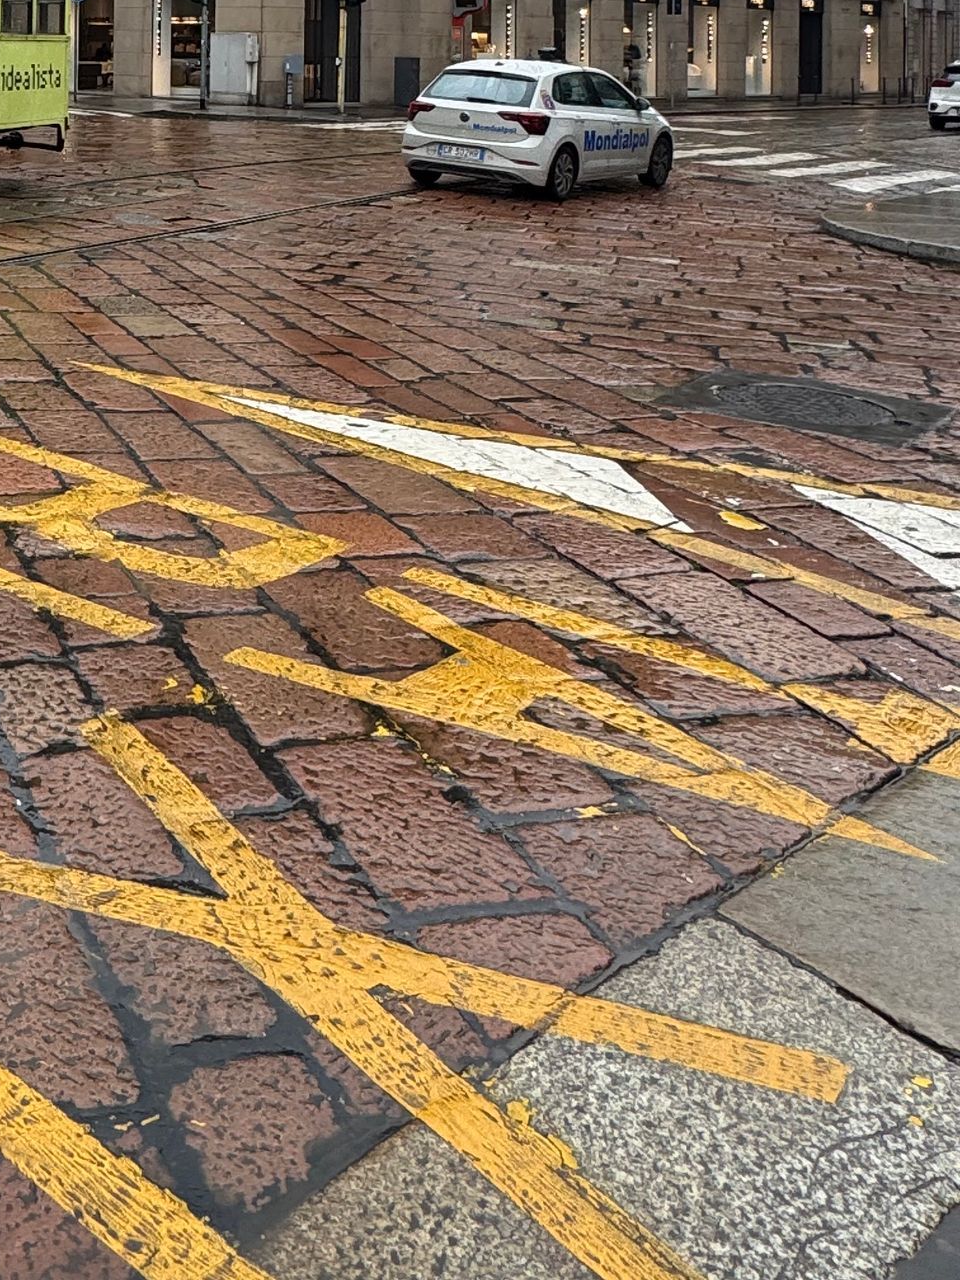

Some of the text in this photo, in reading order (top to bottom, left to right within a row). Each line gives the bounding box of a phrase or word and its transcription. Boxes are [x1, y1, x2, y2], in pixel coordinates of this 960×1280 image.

[0, 63, 62, 92] idealista
[473, 123, 517, 135] Mondialpol
[583, 128, 650, 152] Mondialpol
